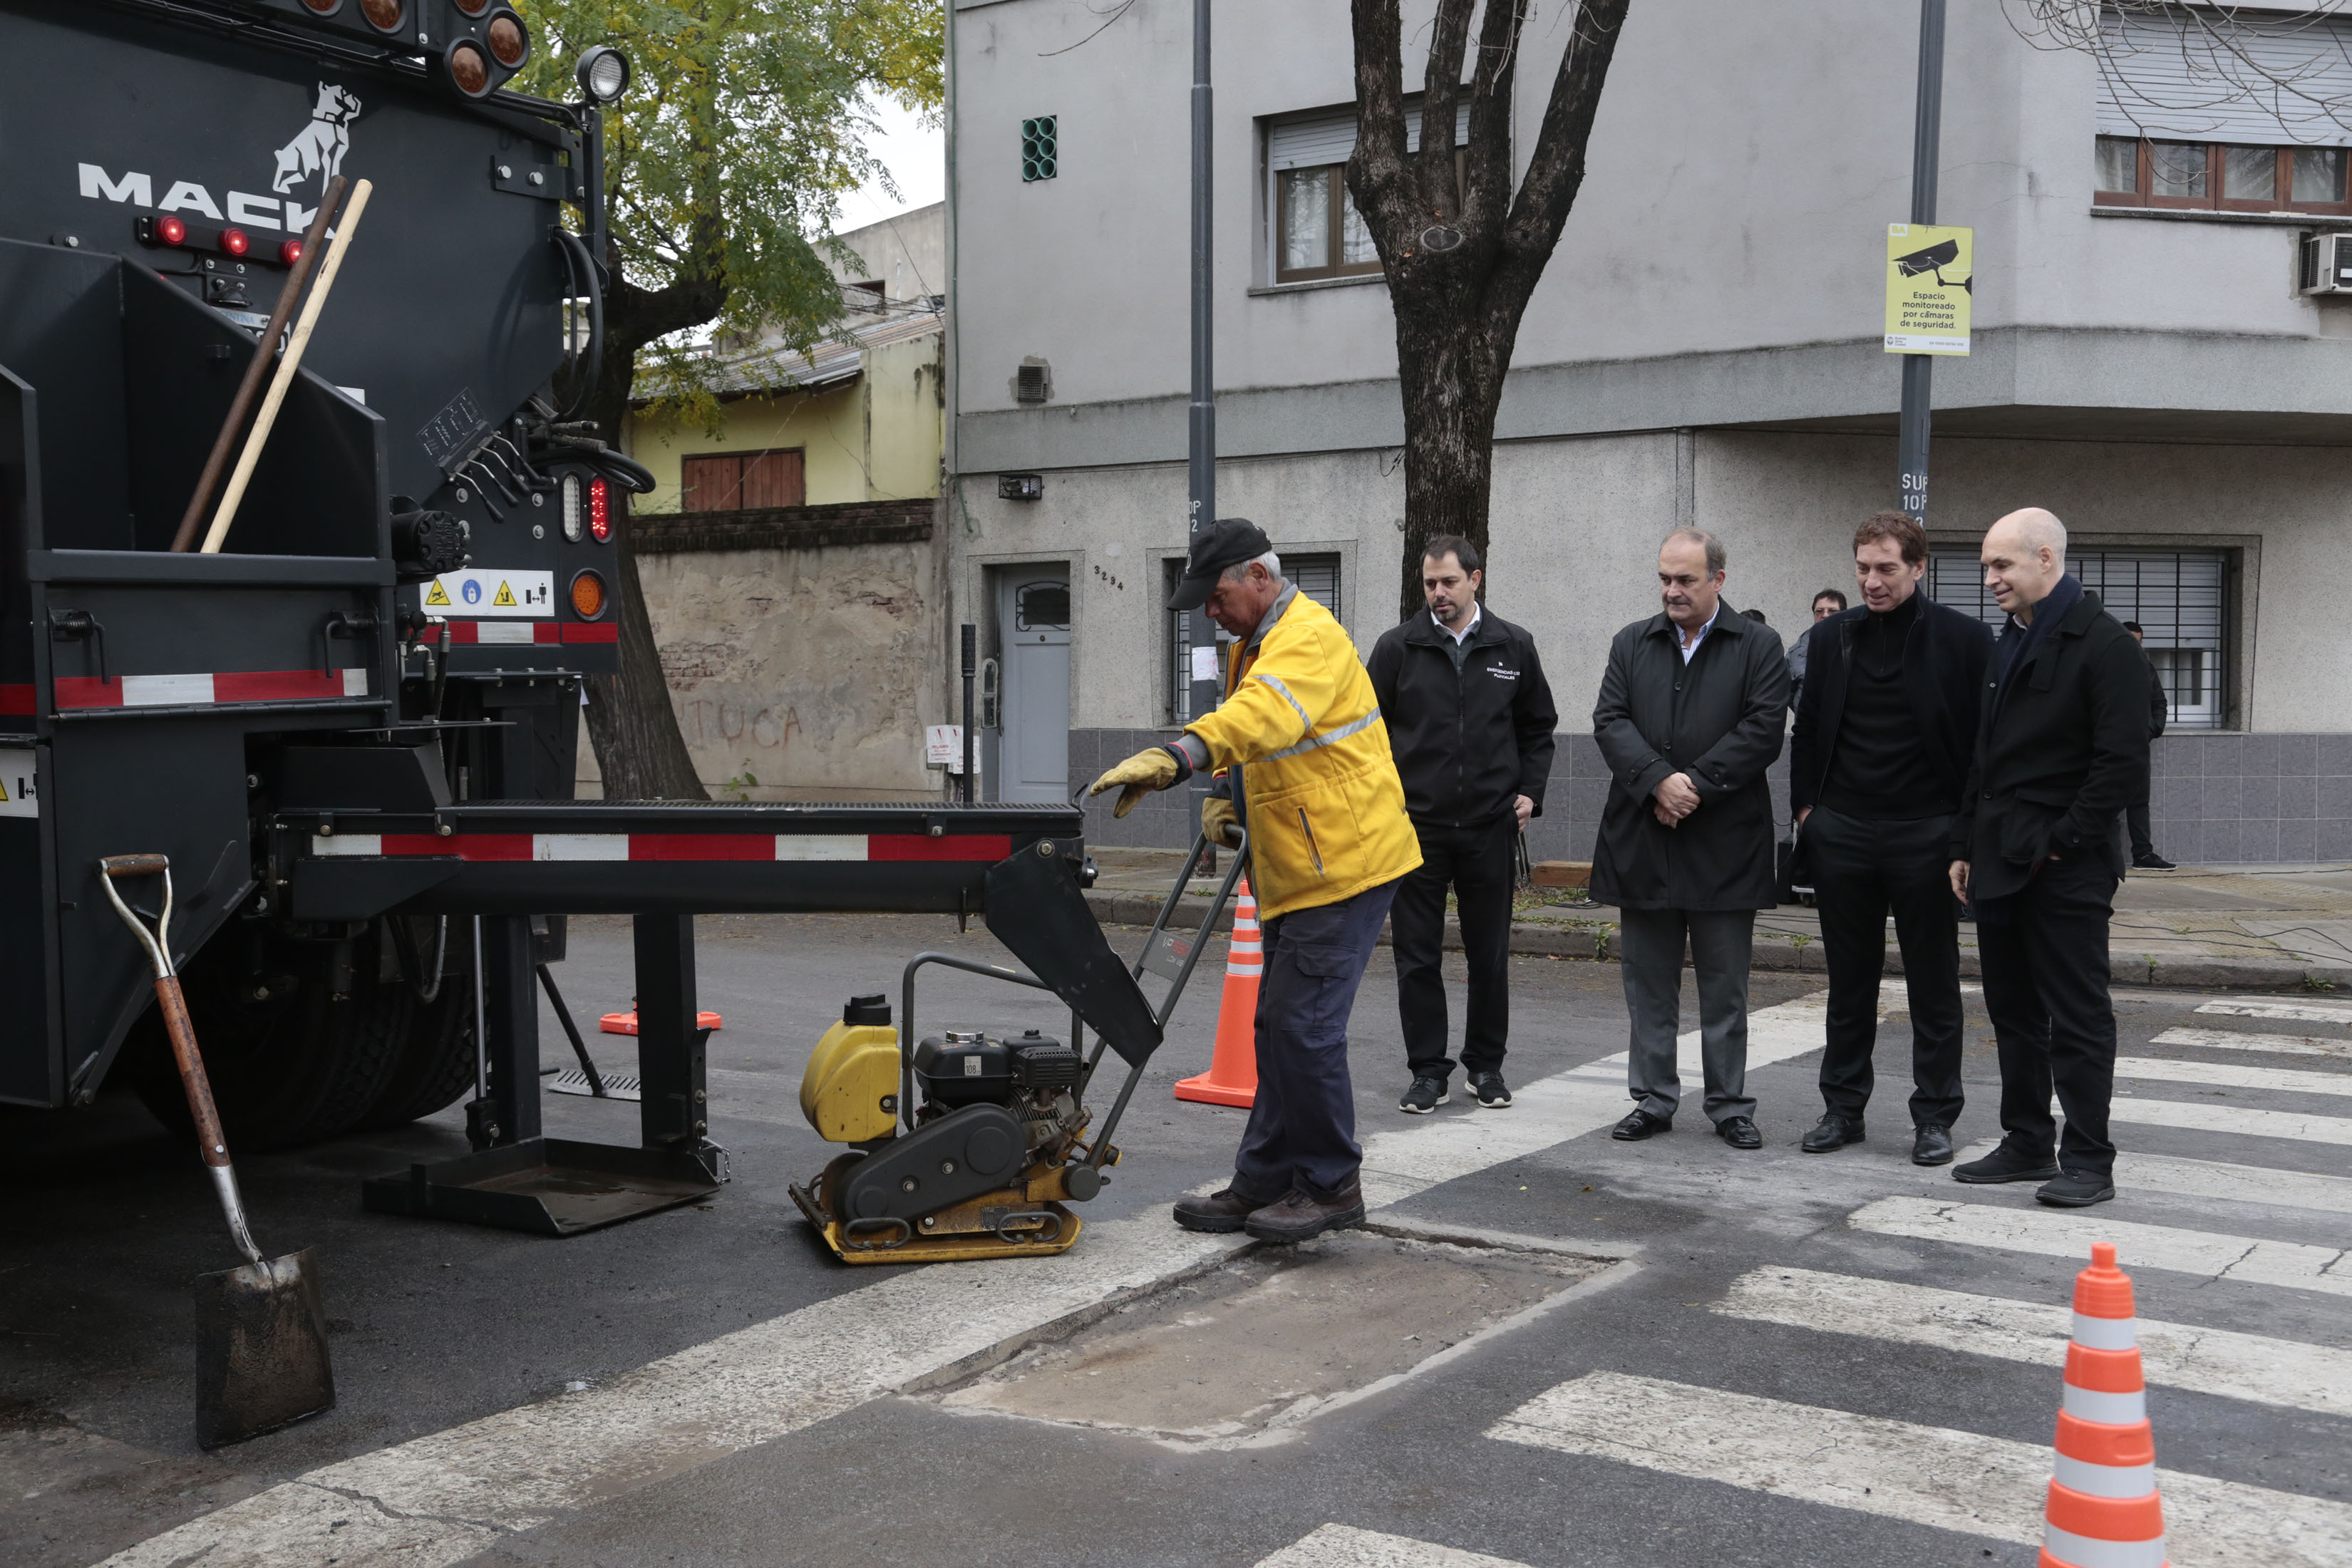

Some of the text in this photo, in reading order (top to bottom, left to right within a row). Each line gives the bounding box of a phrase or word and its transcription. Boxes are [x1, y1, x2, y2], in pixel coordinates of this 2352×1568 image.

[78, 163, 352, 242] MACK
[1913, 292, 1946, 300] Espacio
[1902, 301, 1956, 310] monitoreado
[1920, 311, 1954, 319] cámaras
[1913, 321, 1956, 329] seguridad.
[1094, 565, 1124, 591] 3294
[966, 1065, 976, 1074] 108
